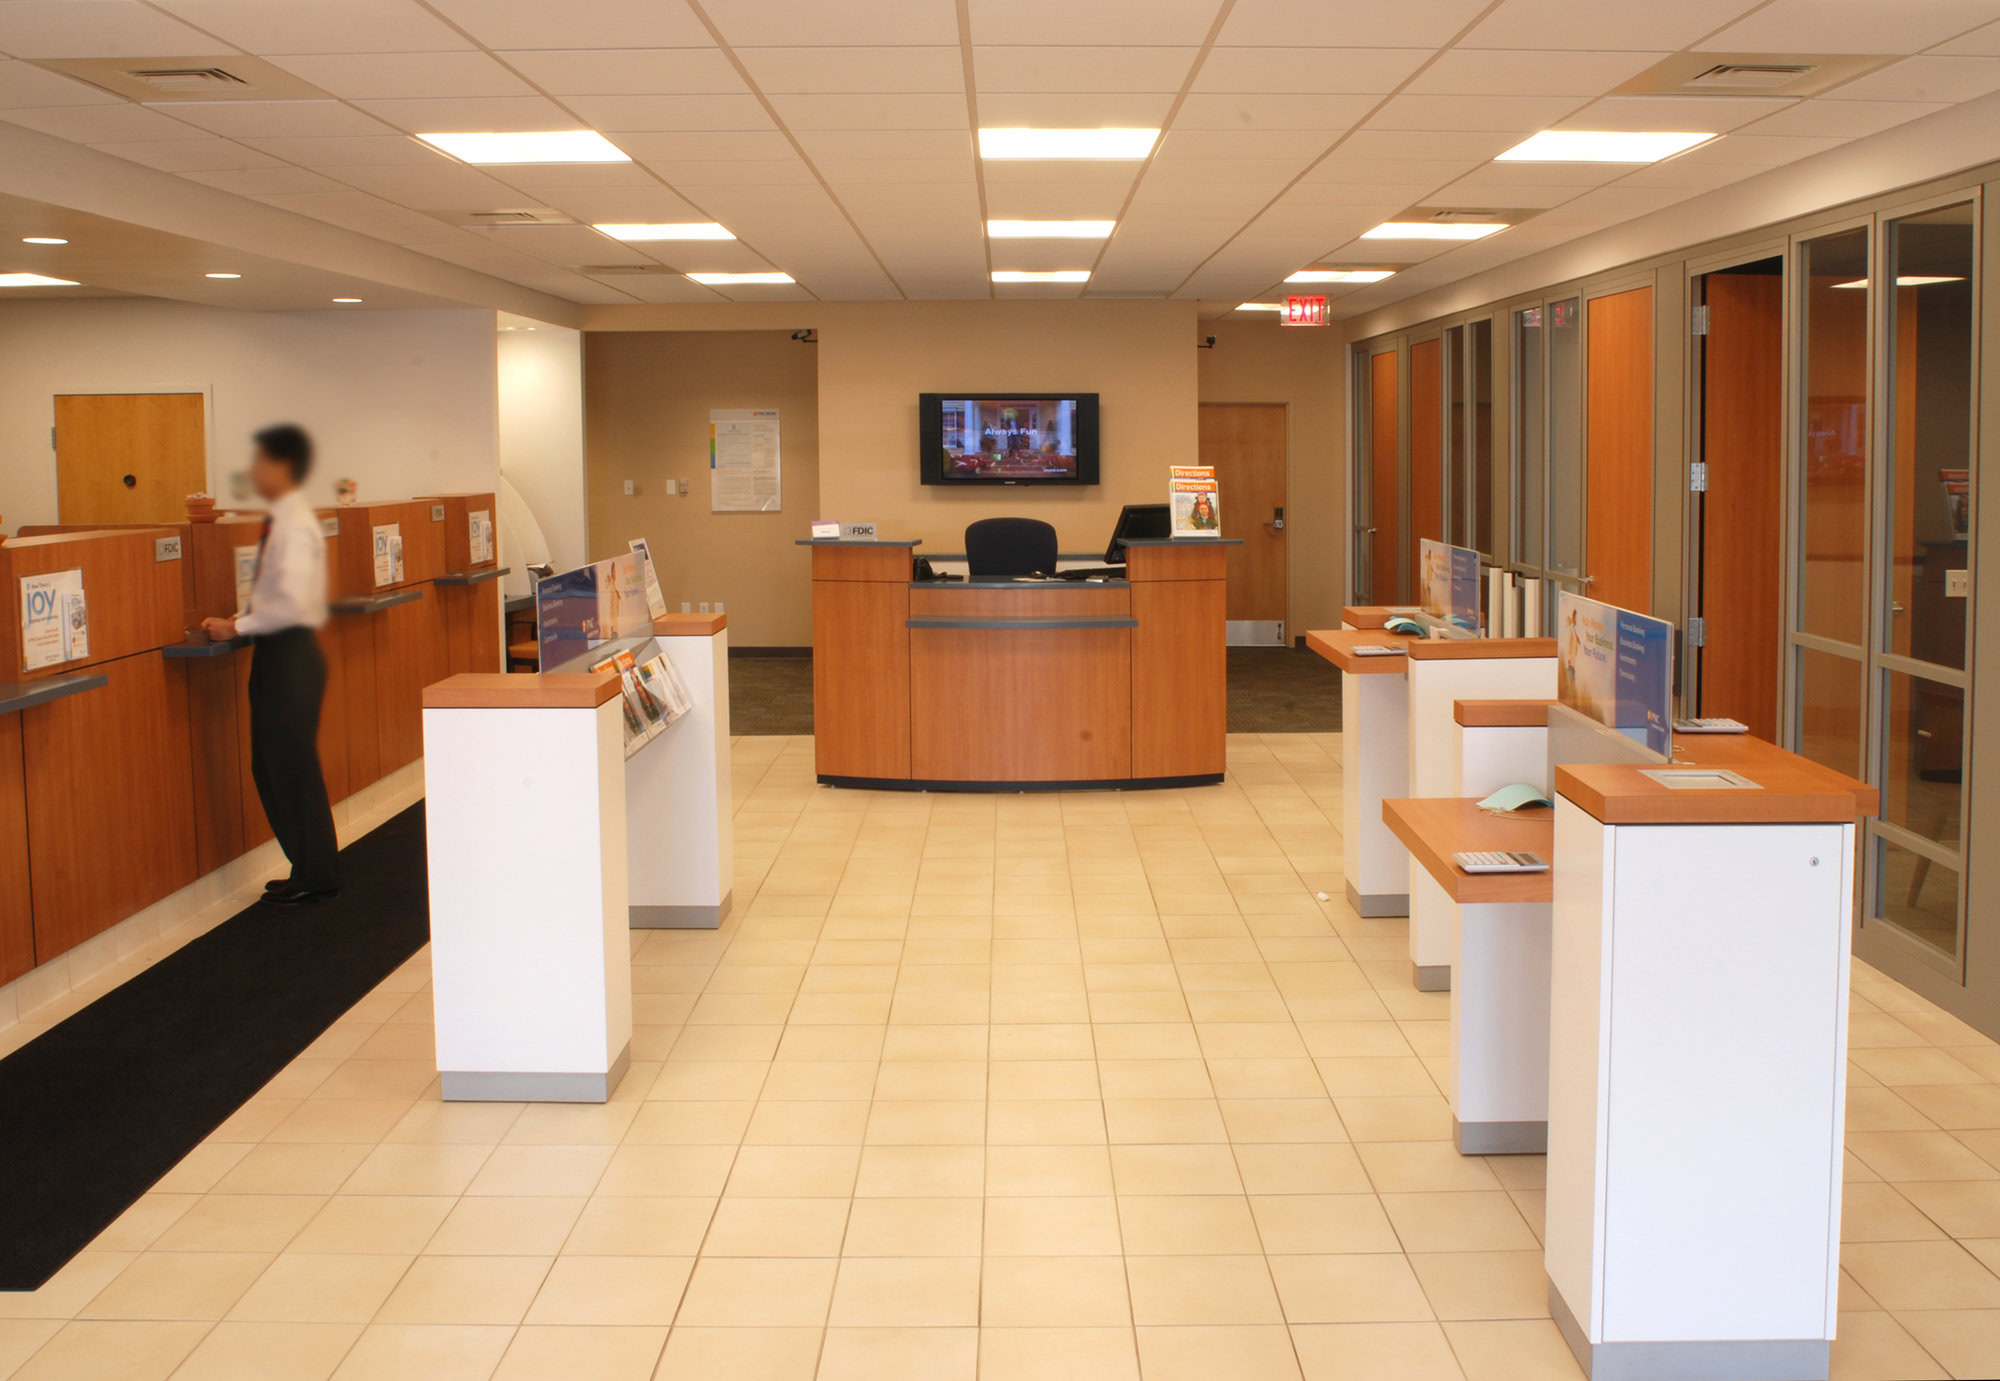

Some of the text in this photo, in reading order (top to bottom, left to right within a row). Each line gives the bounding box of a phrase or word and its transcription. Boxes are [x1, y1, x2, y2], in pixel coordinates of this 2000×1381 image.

[1288, 297, 1326, 323] EXIT
[984, 428, 1038, 437] Always Fun
[1175, 469, 1210, 477] Directions
[1175, 483, 1211, 491] Directions
[852, 526, 874, 535] FDIC
